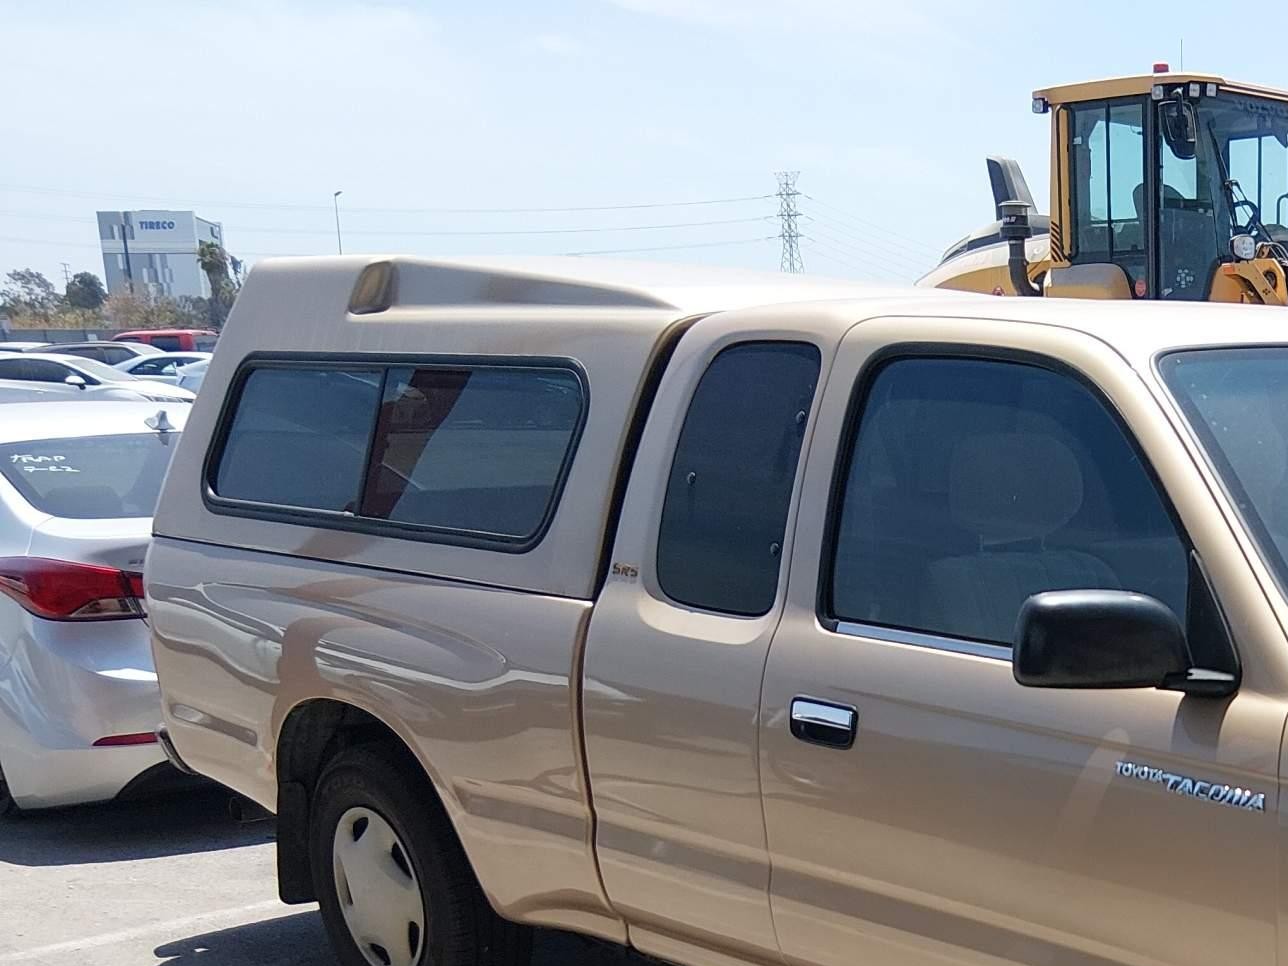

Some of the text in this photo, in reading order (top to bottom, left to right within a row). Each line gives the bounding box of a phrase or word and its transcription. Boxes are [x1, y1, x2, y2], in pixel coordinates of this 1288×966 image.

[139, 221, 175, 230] TIRECO
[1115, 761, 1265, 811] TOYOTA TACOMA
